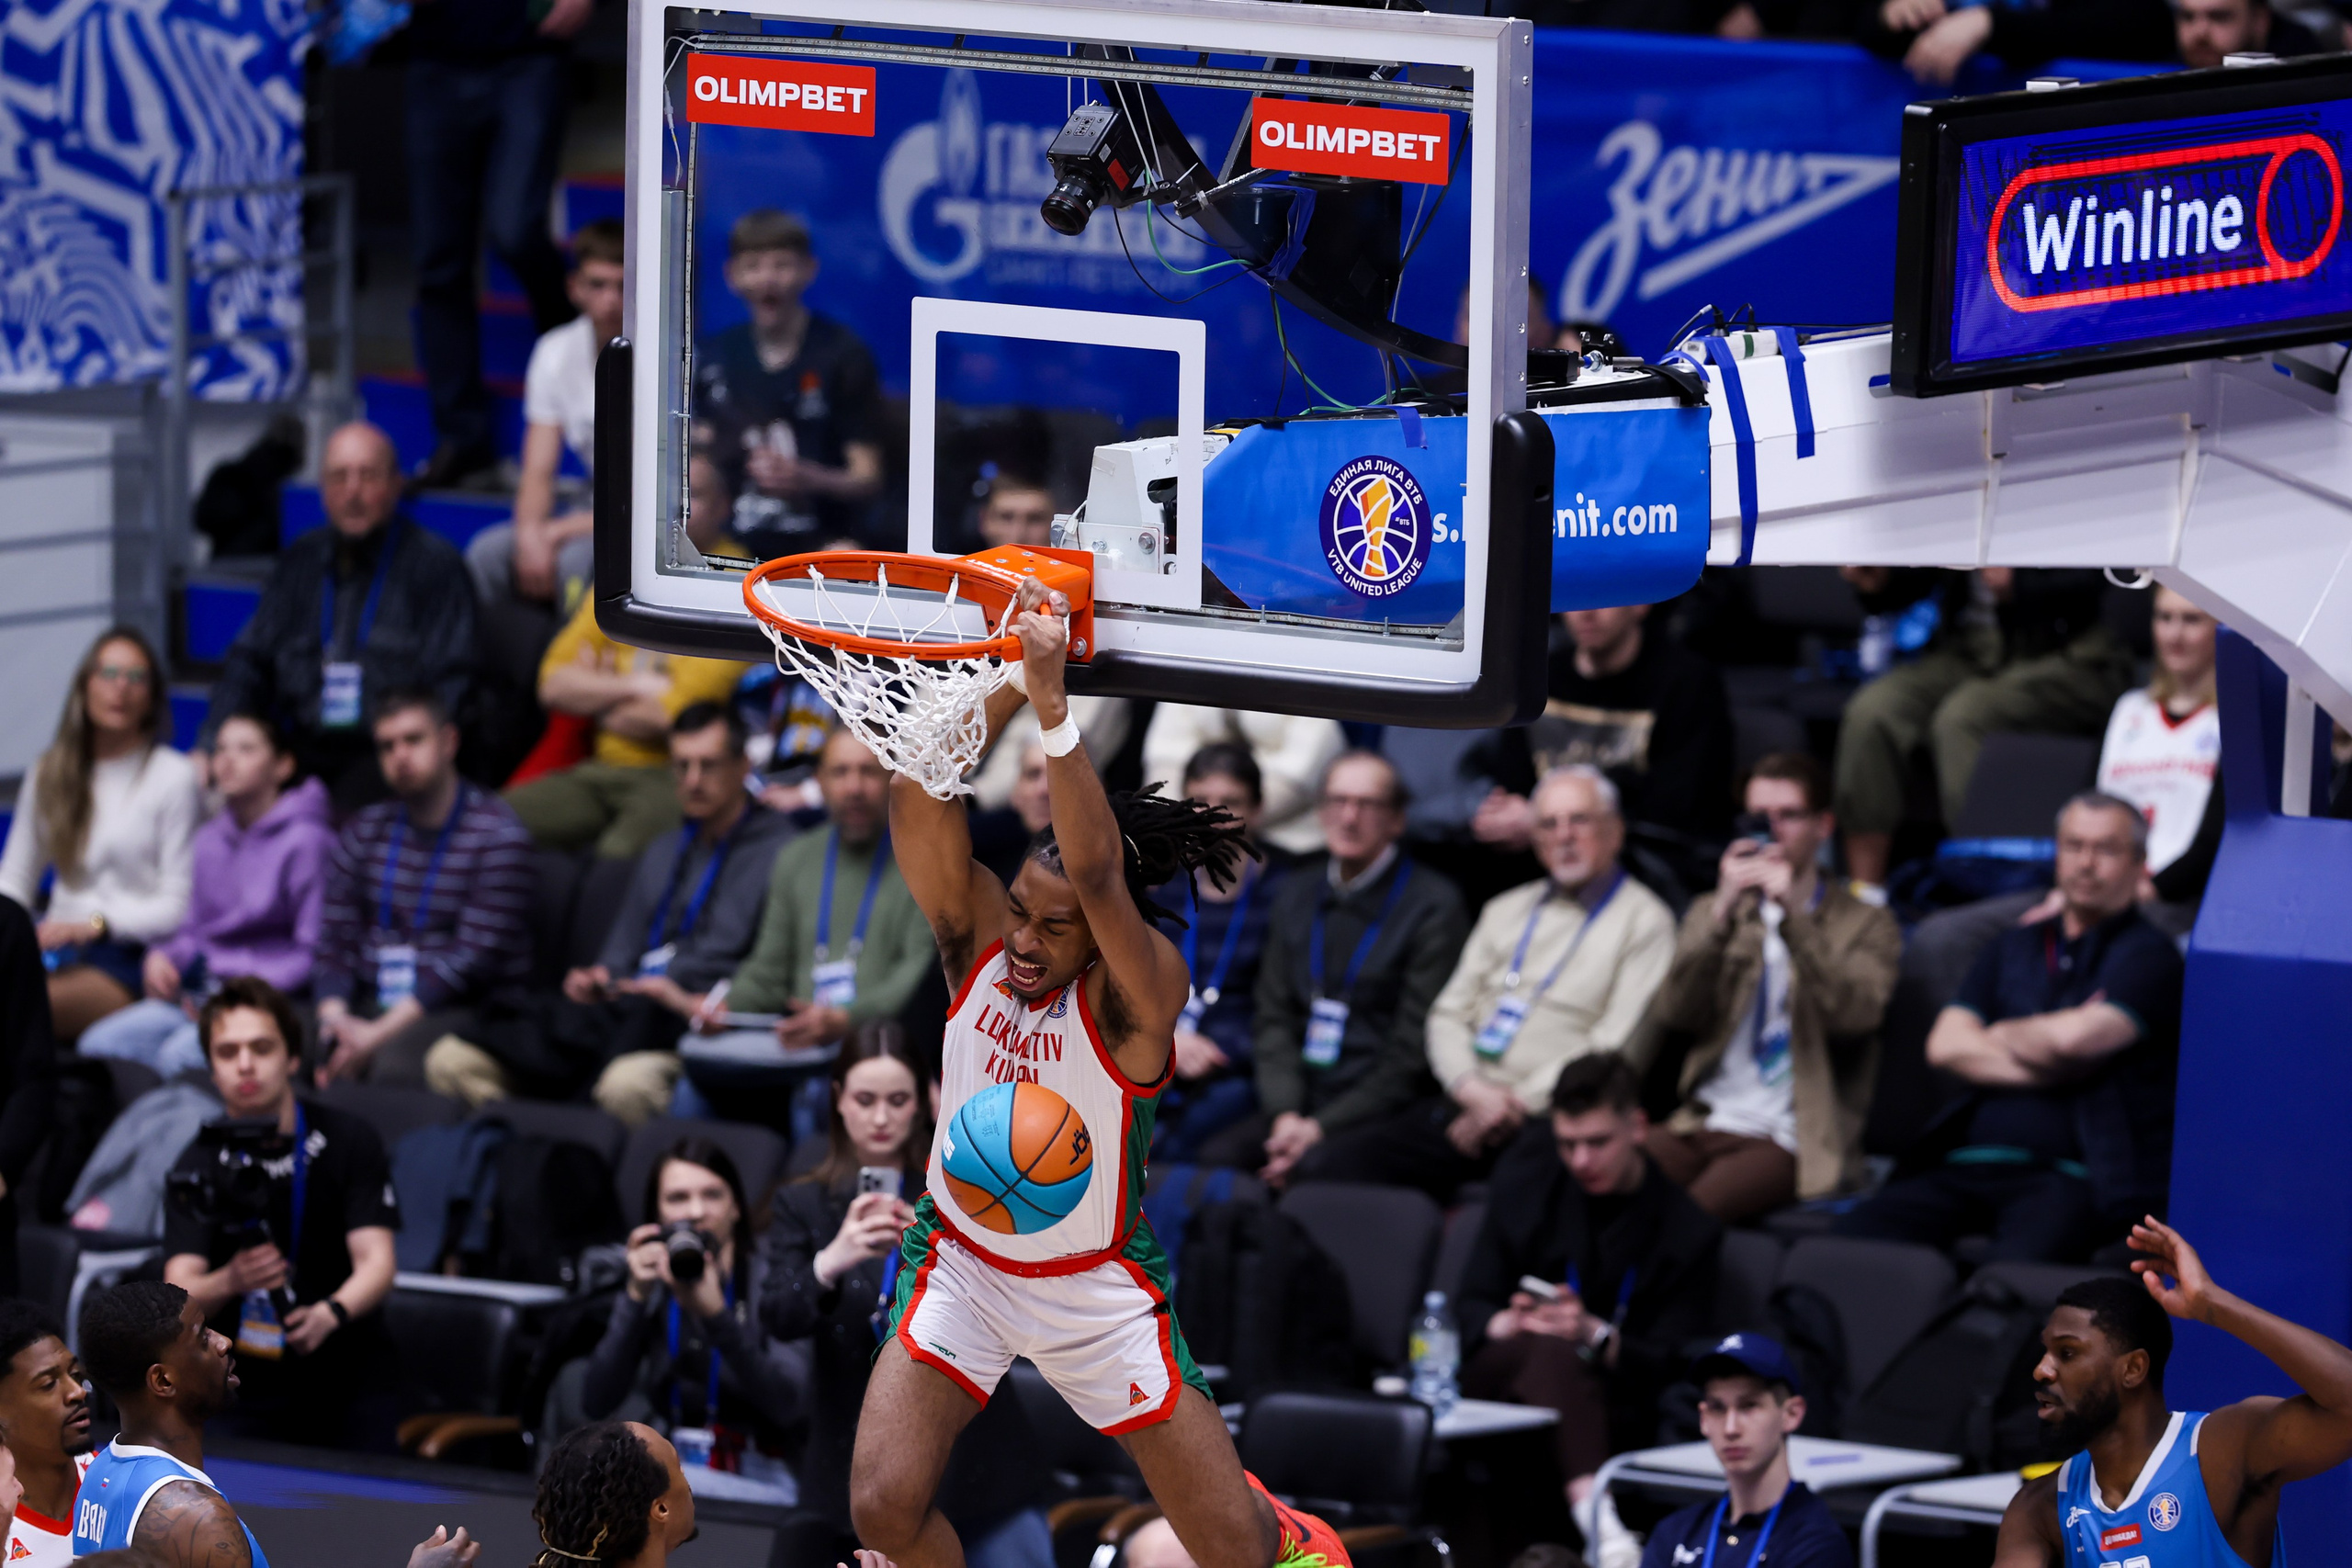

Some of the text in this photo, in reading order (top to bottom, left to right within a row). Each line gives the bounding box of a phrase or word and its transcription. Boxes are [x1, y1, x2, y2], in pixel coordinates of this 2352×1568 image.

[694, 75, 868, 114] OLIMPBET
[1259, 120, 1441, 161] OLIMPBET
[2022, 185, 2245, 275] Winline
[1329, 459, 1423, 505] ЕДИНАЯ ЛИГА ВТБ
[1552, 491, 1679, 538] nit.com
[1328, 548, 1423, 596] VTB UNITED LEAGUE
[974, 1003, 1063, 1062] LOKMTIV
